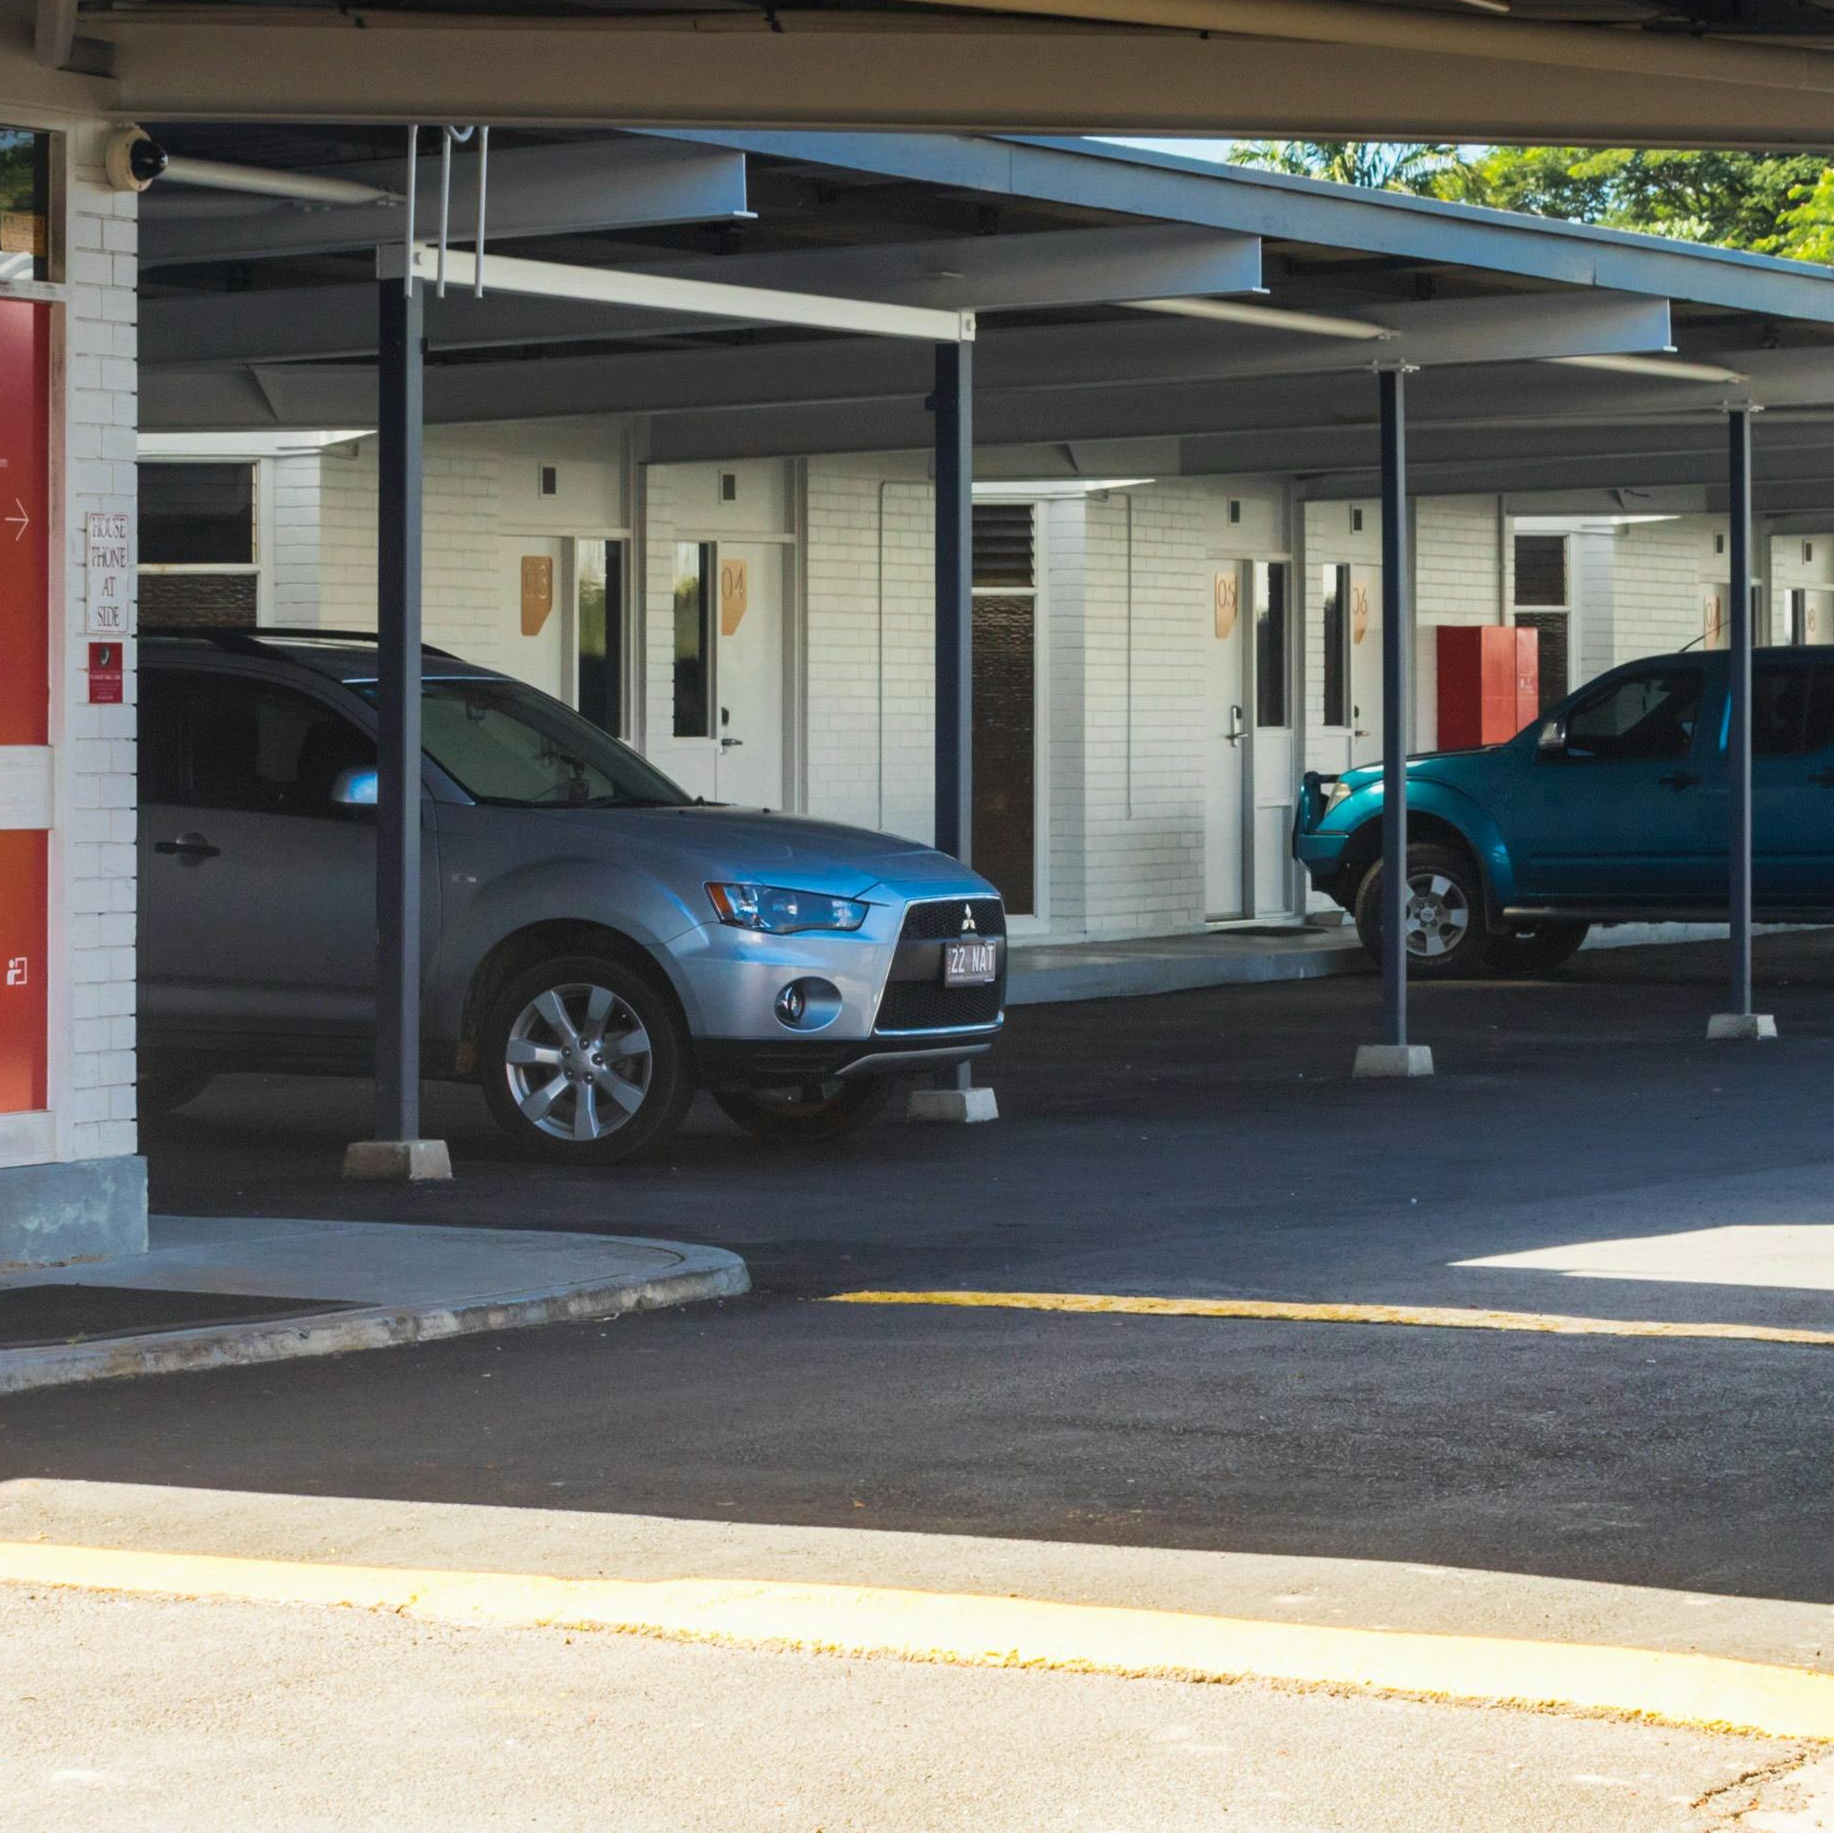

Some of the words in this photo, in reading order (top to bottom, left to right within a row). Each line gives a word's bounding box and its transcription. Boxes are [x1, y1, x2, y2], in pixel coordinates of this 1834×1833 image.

[91, 517, 127, 539] HOUSE
[91, 546, 127, 568] PHONE
[101, 576, 116, 598] AT
[721, 567, 745, 599] 04
[97, 606, 120, 627] SIDE
[951, 948, 966, 974] 22
[972, 945, 995, 972] NAT
